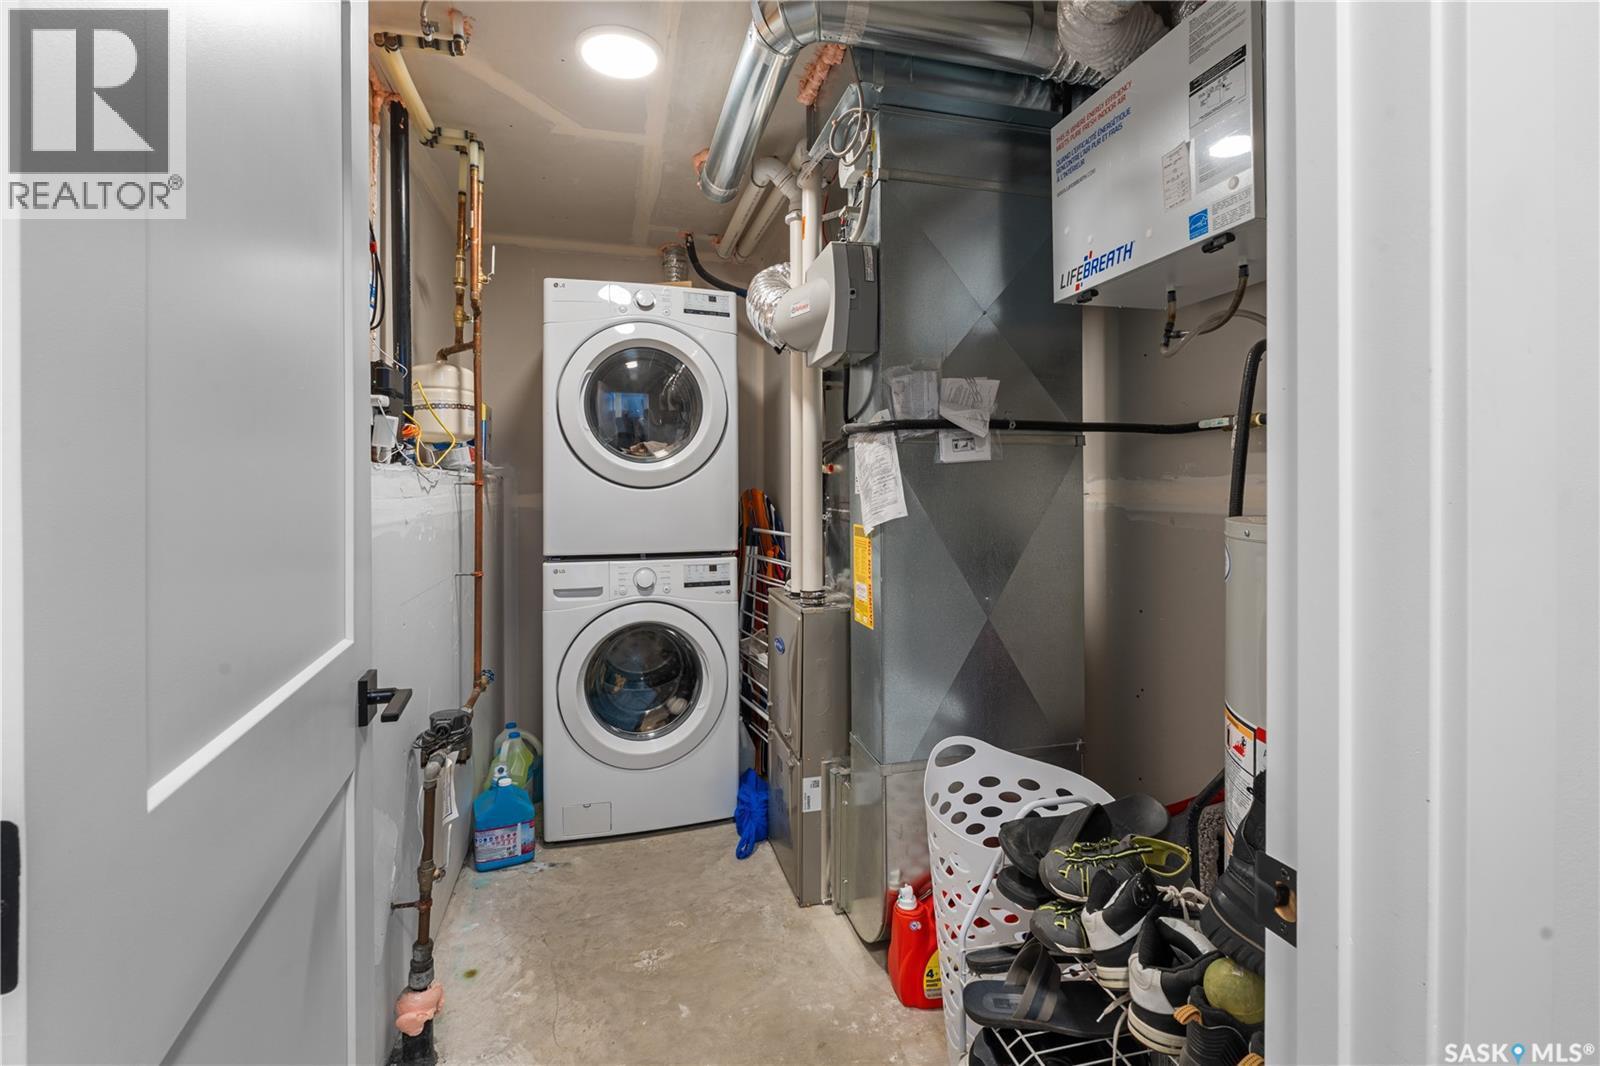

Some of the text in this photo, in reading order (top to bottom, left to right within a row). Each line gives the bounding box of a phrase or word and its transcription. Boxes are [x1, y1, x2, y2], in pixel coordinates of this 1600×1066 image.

[1087, 103, 1104, 121] ENERGY
[1105, 80, 1132, 106] EFFICIENCY
[1060, 242, 1133, 289] LIFEBREATH
